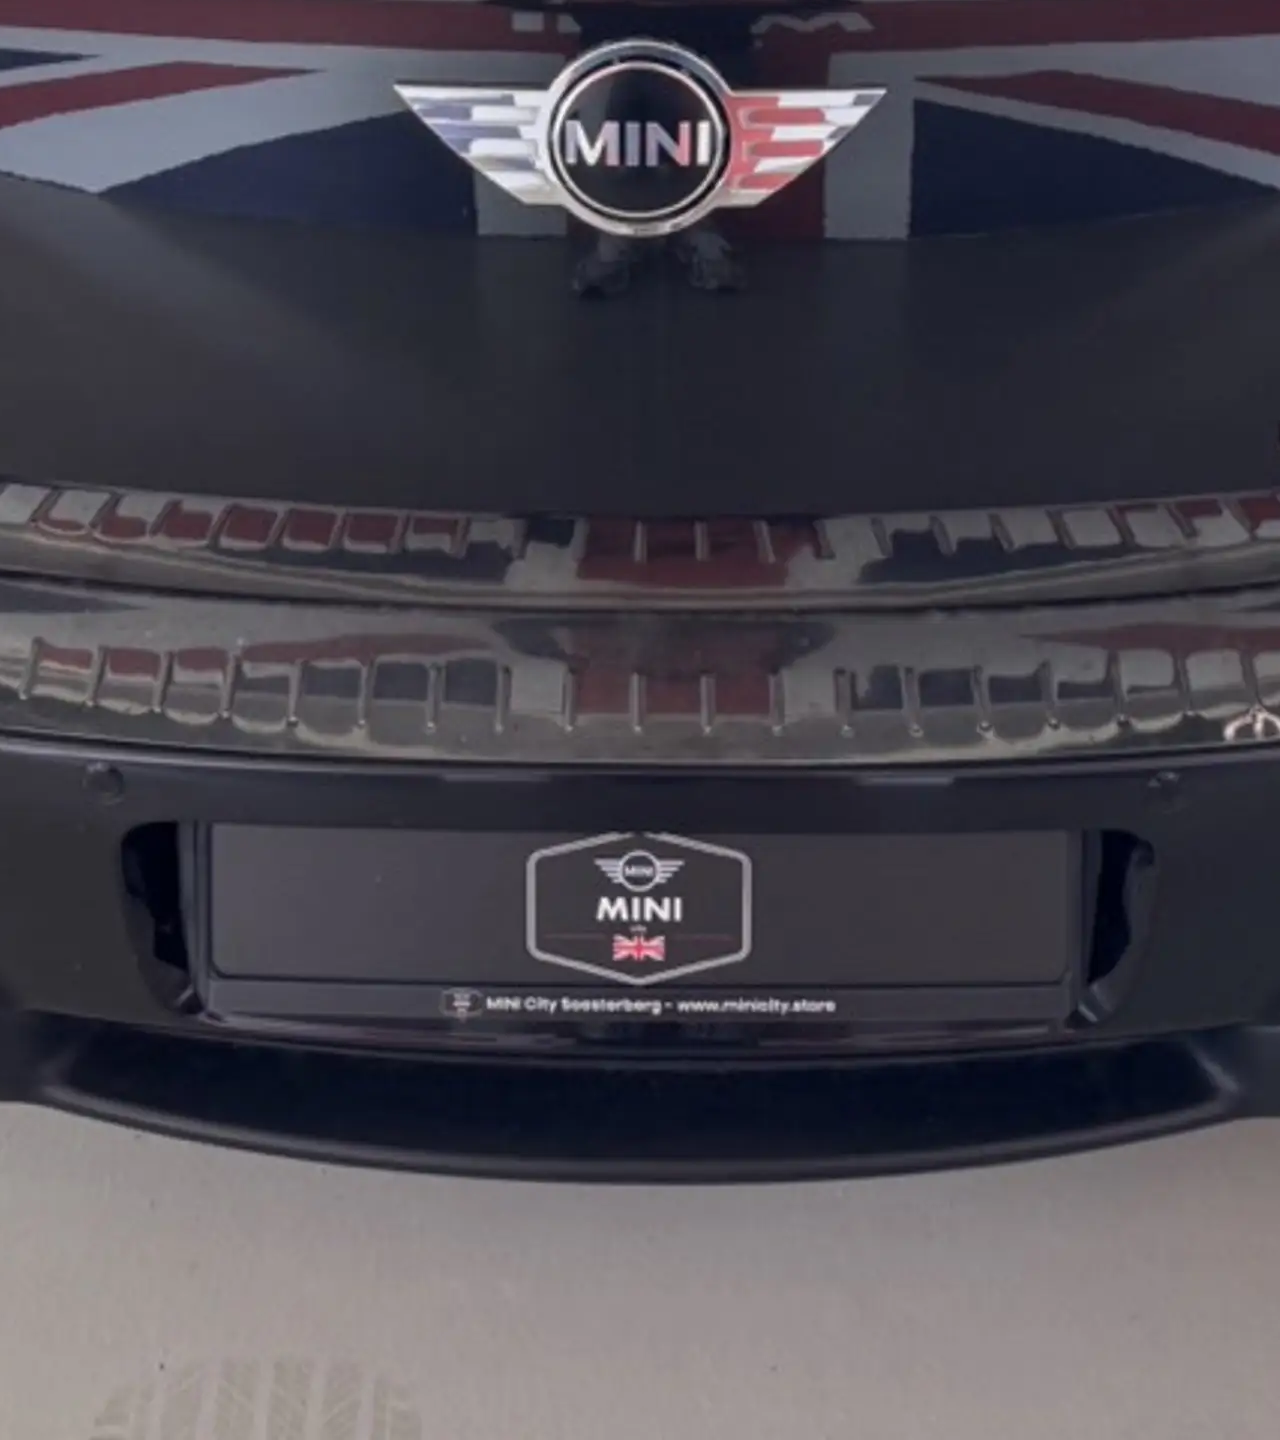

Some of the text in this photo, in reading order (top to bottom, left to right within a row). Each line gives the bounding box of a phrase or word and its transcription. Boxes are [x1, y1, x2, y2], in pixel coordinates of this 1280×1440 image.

[565, 120, 710, 166] MINI
[596, 896, 682, 921] MINI
[486, 996, 520, 1011] MINI
[524, 996, 557, 1015] City
[677, 997, 836, 1015] www.minicity.store
